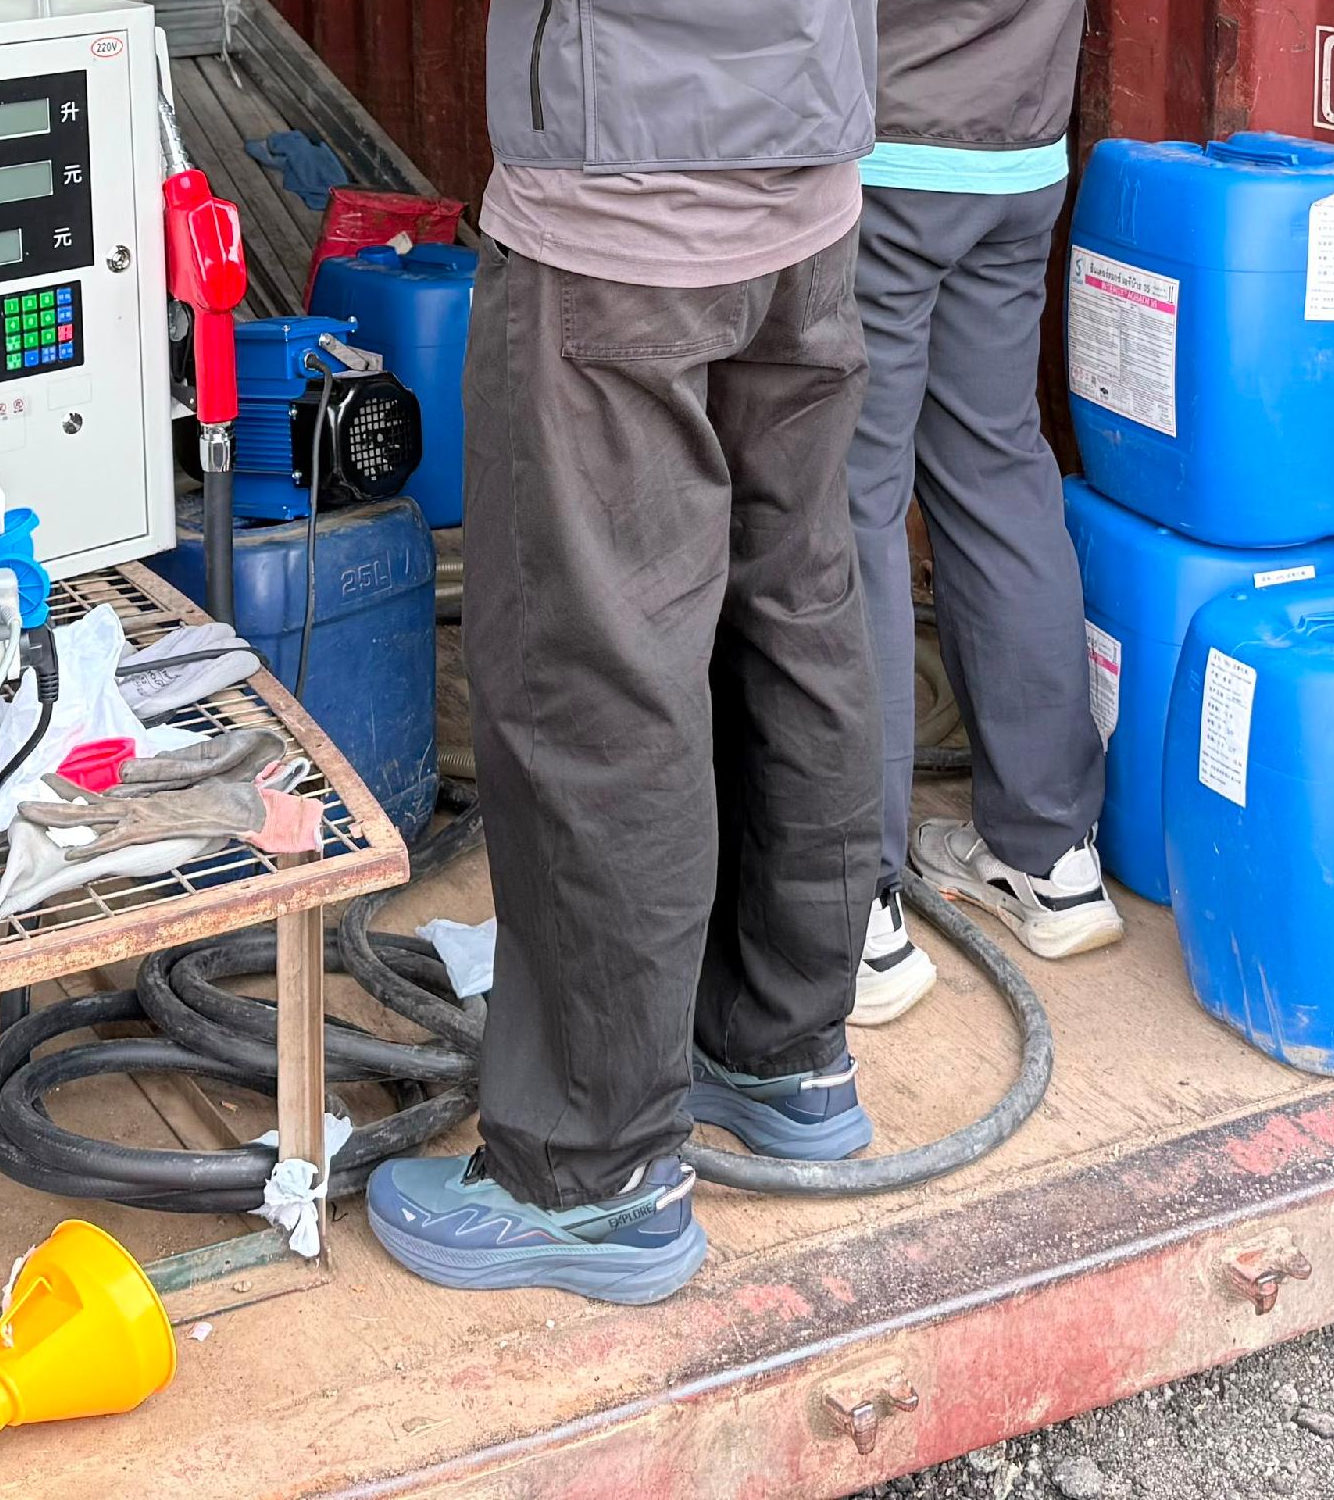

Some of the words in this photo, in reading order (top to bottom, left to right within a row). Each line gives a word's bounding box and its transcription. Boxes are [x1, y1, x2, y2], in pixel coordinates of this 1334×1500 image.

[97, 41, 117, 53] 220V
[61, 101, 80, 123] 升
[63, 164, 83, 185] 元
[53, 227, 72, 249] 元
[607, 1202, 653, 1230] EXPLORE
